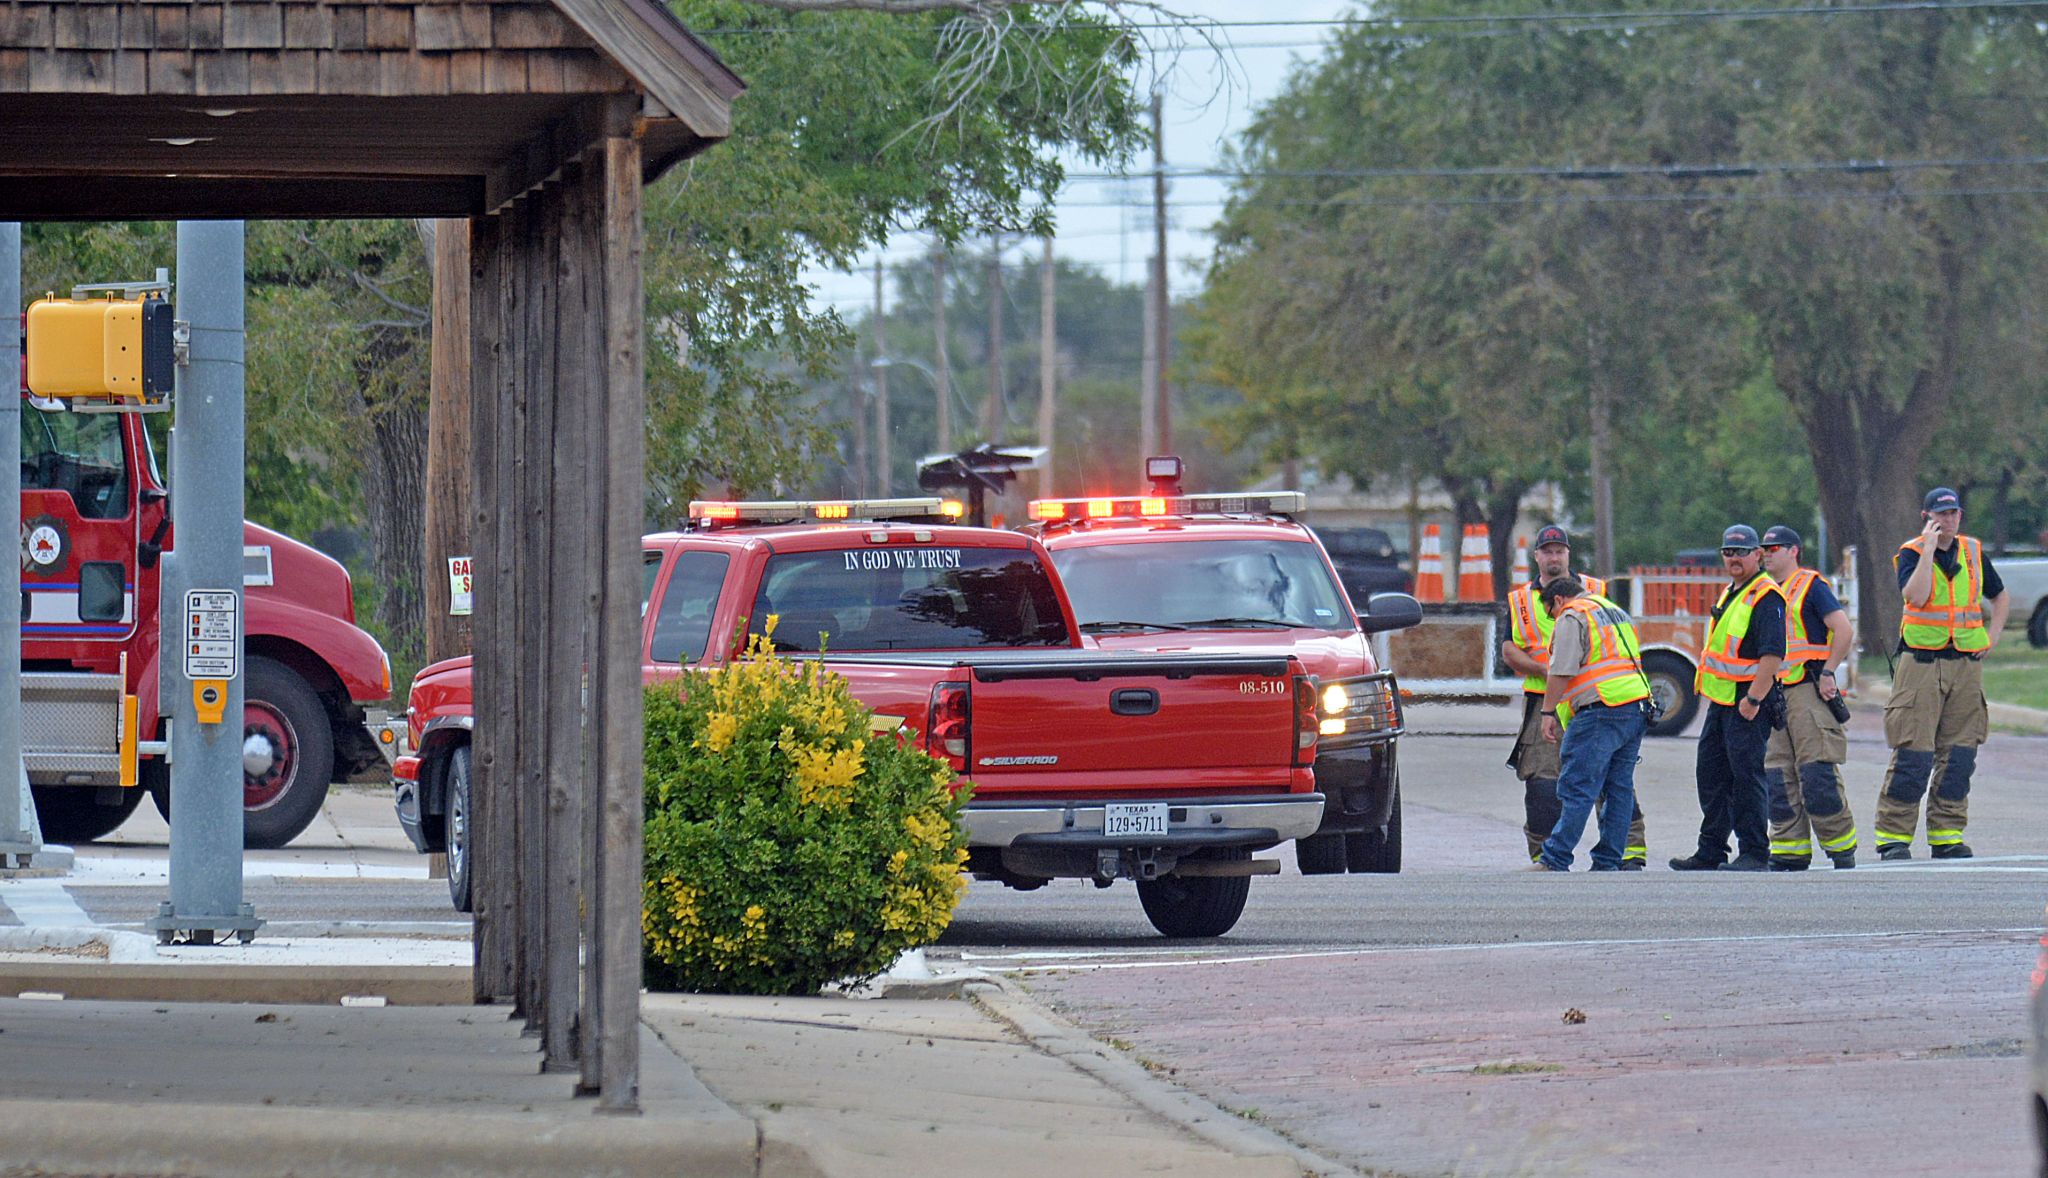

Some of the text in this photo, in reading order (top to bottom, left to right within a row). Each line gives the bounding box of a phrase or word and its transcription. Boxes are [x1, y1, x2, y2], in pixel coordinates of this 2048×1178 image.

[844, 549, 961, 570] IN GOD WE TRUST
[453, 560, 474, 576] GA
[1240, 681, 1284, 694] 08-510
[994, 756, 1058, 766] SILVERADO
